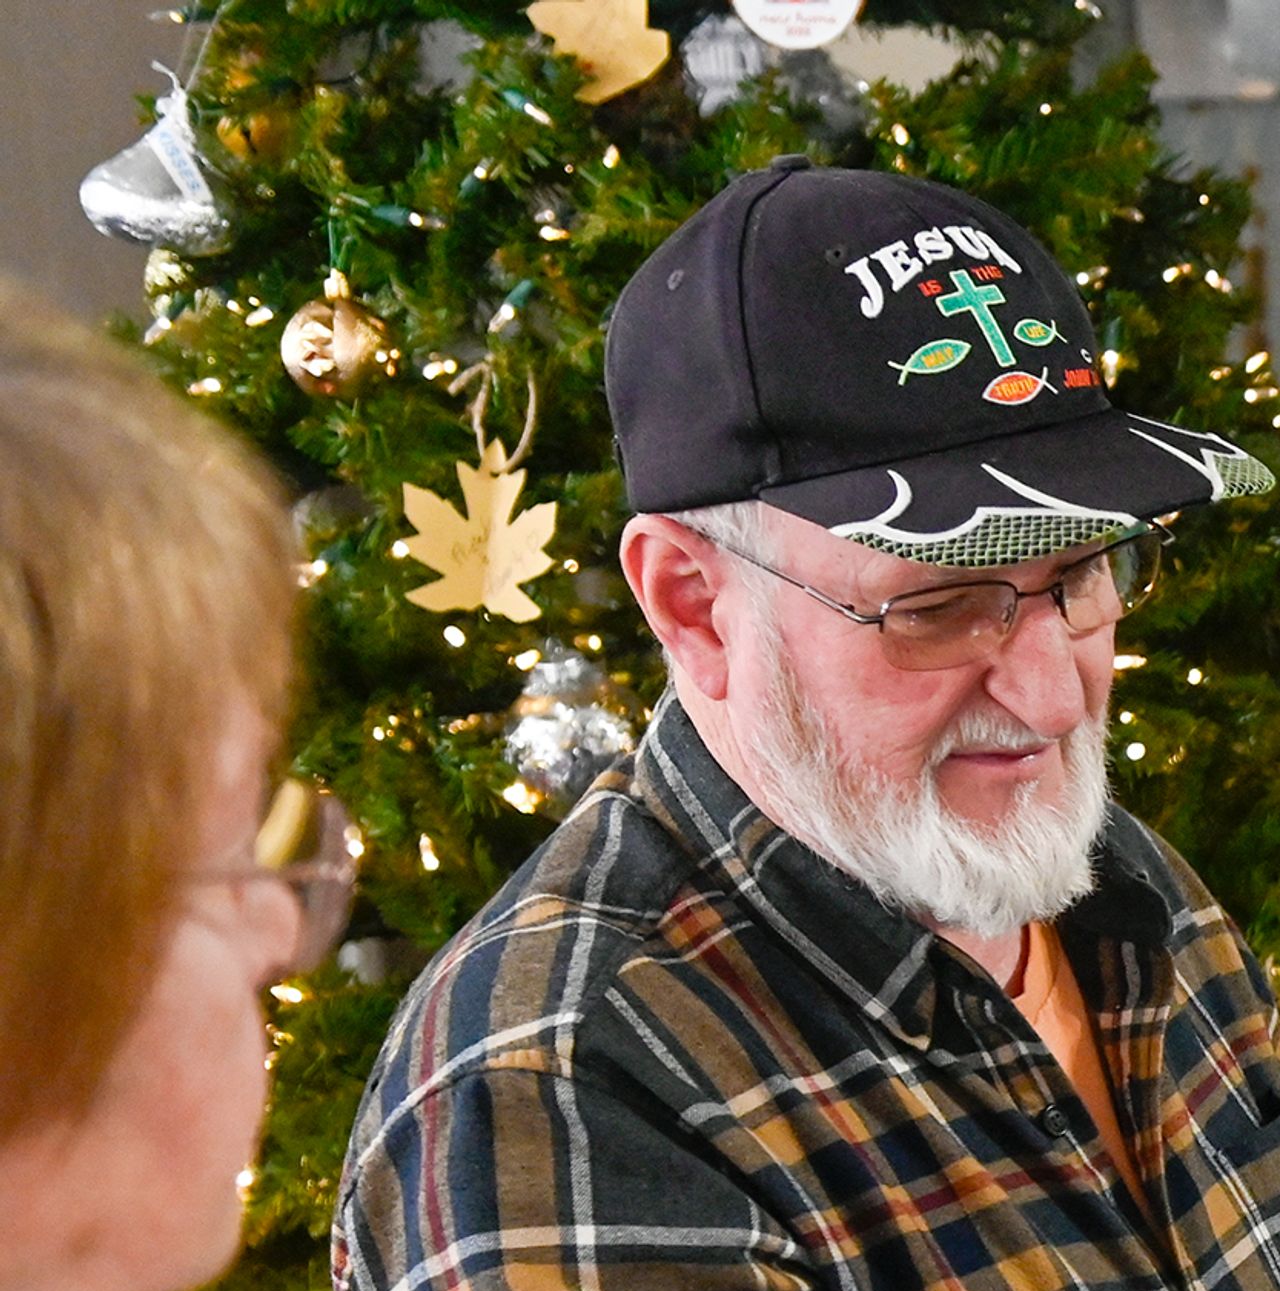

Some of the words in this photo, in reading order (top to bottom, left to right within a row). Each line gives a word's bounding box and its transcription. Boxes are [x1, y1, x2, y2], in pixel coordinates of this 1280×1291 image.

[918, 279, 943, 297] IS
[970, 264, 1005, 282] THE
[921, 346, 956, 369] WAY
